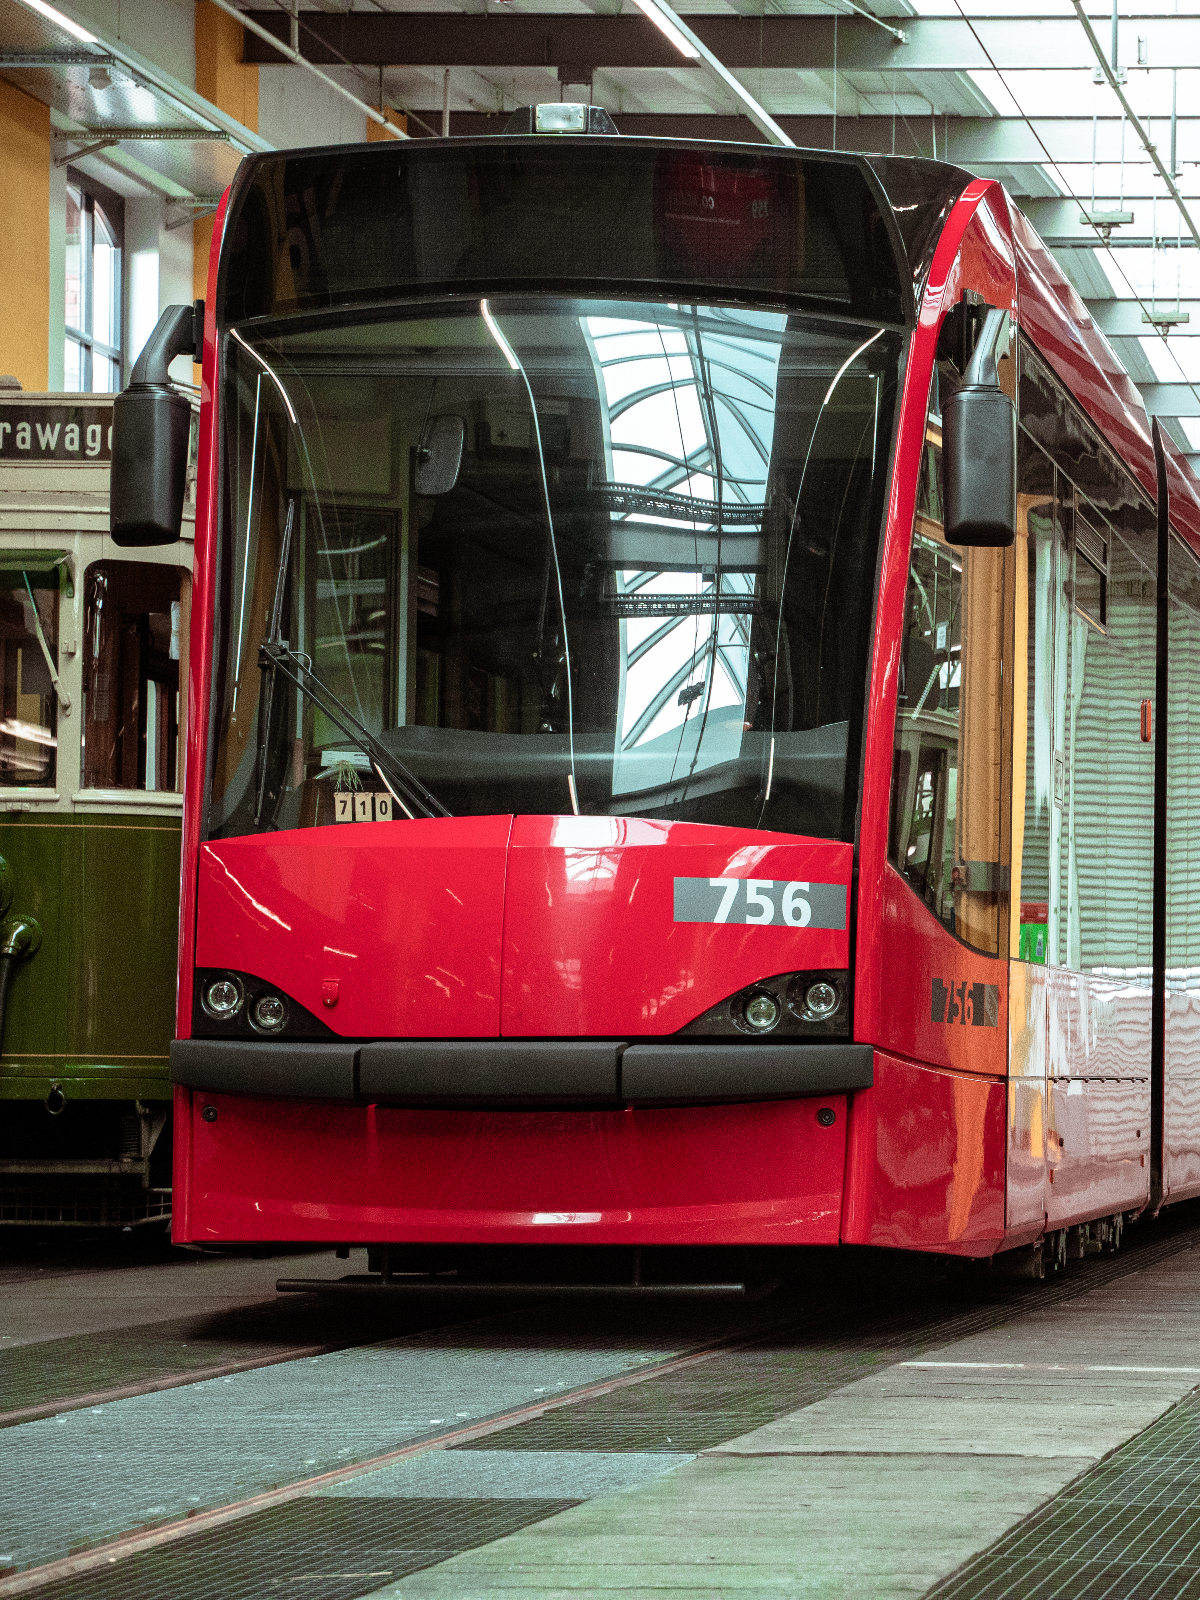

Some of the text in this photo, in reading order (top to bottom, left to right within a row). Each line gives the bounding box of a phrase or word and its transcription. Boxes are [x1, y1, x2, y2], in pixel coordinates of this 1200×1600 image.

[0, 421, 112, 457] rawag
[339, 799, 388, 816] 710
[709, 877, 812, 928] 756
[942, 979, 974, 1026] 756
